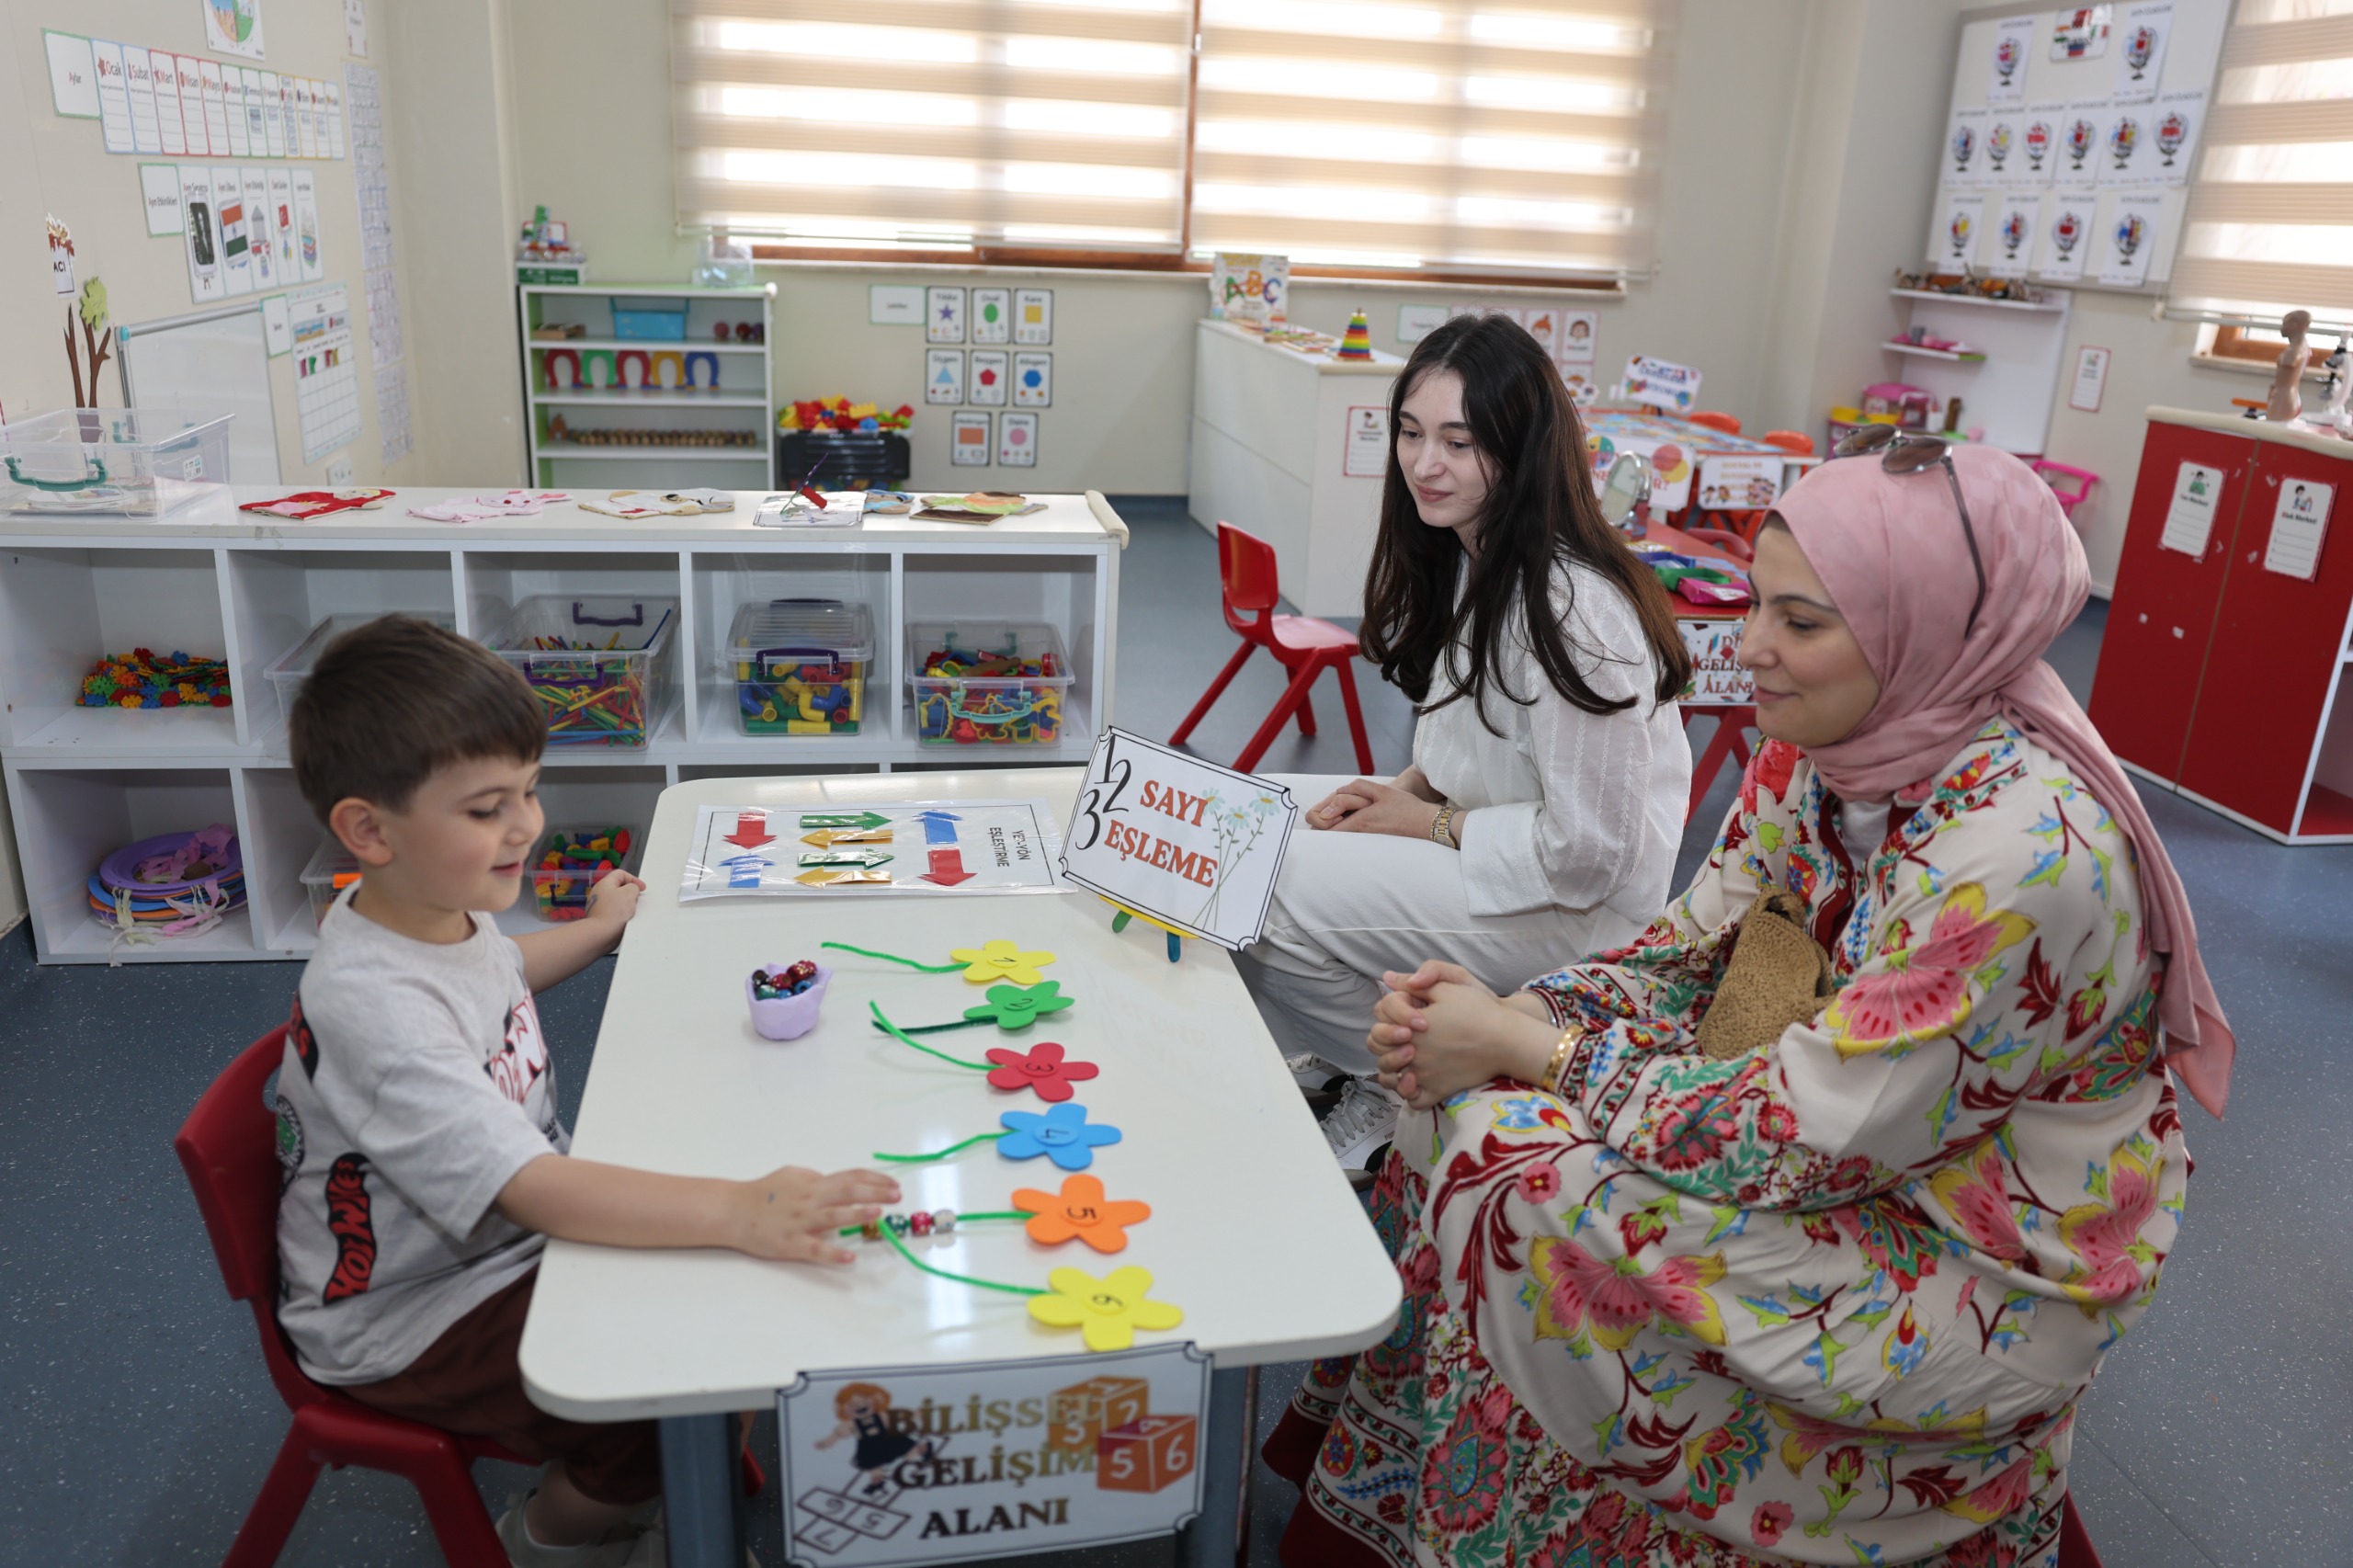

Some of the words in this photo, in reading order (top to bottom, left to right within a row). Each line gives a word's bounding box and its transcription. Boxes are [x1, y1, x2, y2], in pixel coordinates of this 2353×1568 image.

[106, 59, 122, 77] Ocak
[131, 64, 150, 83] Şubat
[160, 70, 174, 85] Mart
[53, 260, 66, 273] ACI
[1722, 632, 1743, 649] Dİ
[1699, 656, 1754, 675] GELİŞ
[1103, 759, 1131, 813] 2
[1075, 789, 1101, 850] 3
[1140, 779, 1209, 827] SAYI
[987, 826, 1010, 868] EŞLEŞTİRME
[1104, 819, 1219, 888] EŞLEME
[1009, 998, 1033, 1008] 2
[1025, 1062, 1053, 1073] 3
[1066, 1206, 1097, 1221] 5
[887, 1392, 1101, 1437] BİLİŞSEL
[892, 1441, 1097, 1489] GELİŞİM
[1109, 1447, 1136, 1480] 5
[1165, 1434, 1188, 1471] 6
[918, 1497, 1070, 1540] ALANI
